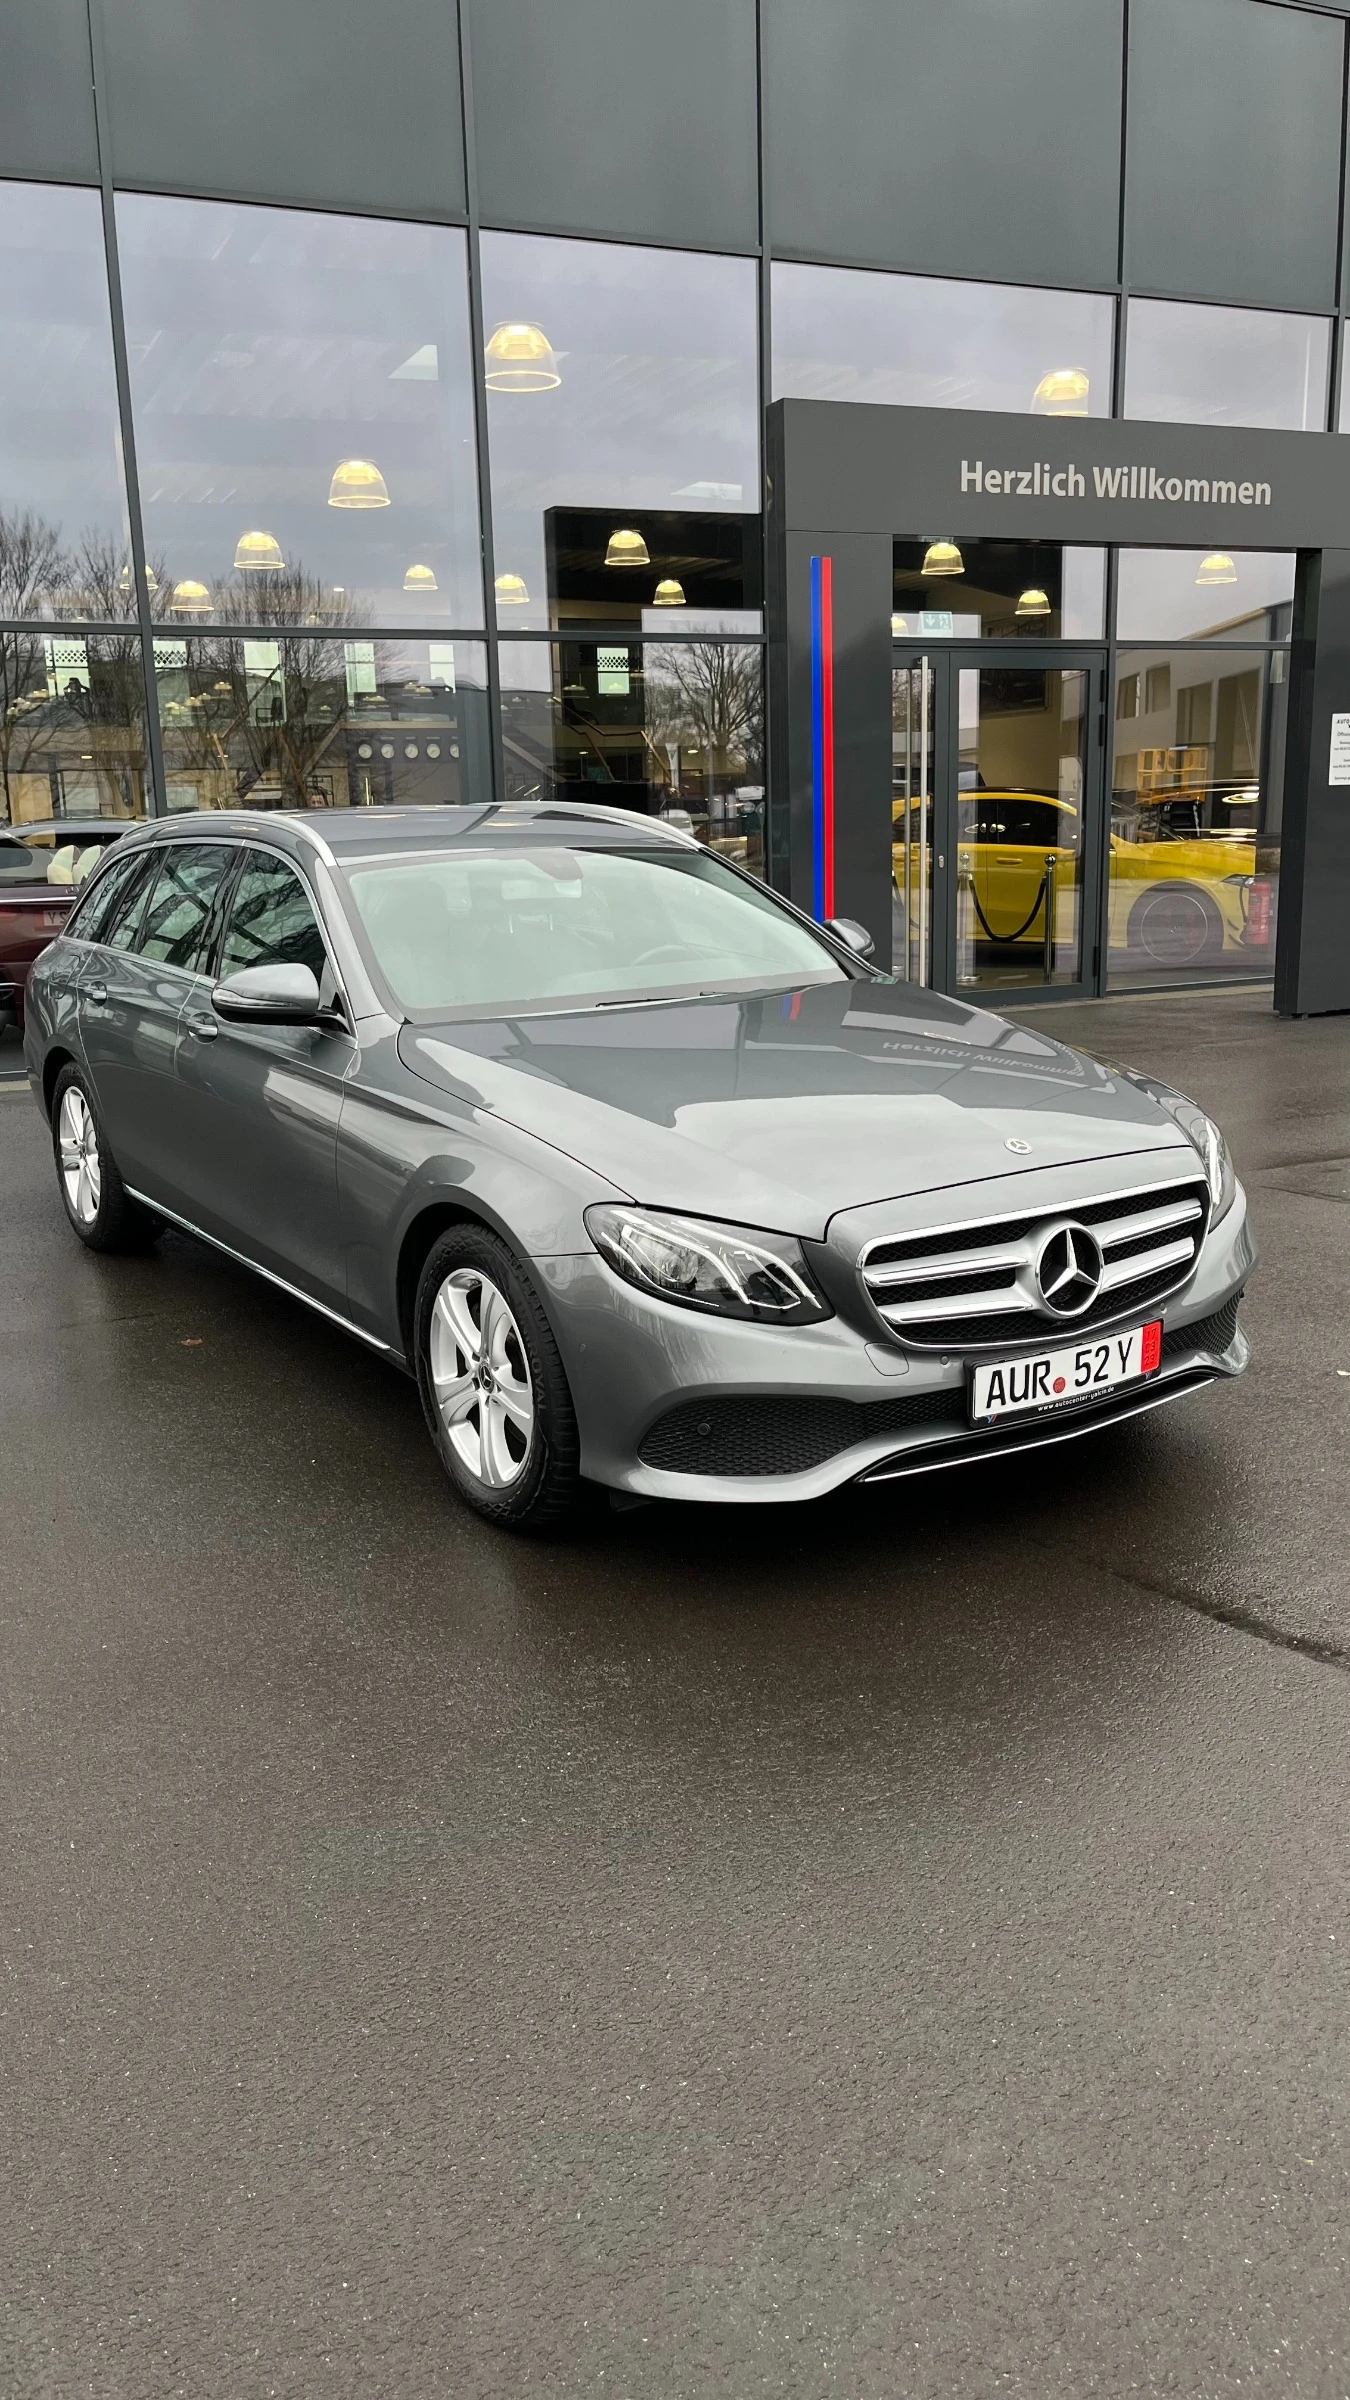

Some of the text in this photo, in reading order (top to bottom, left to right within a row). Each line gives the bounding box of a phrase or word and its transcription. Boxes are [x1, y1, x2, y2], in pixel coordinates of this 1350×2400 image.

[960, 460, 1272, 506] Herzlich Willkommen
[1146, 1327, 1157, 1341] 17
[986, 1336, 1134, 1409] AUR 52 Y
[1037, 1385, 1115, 1412] www.autocenter-yalcin.de
